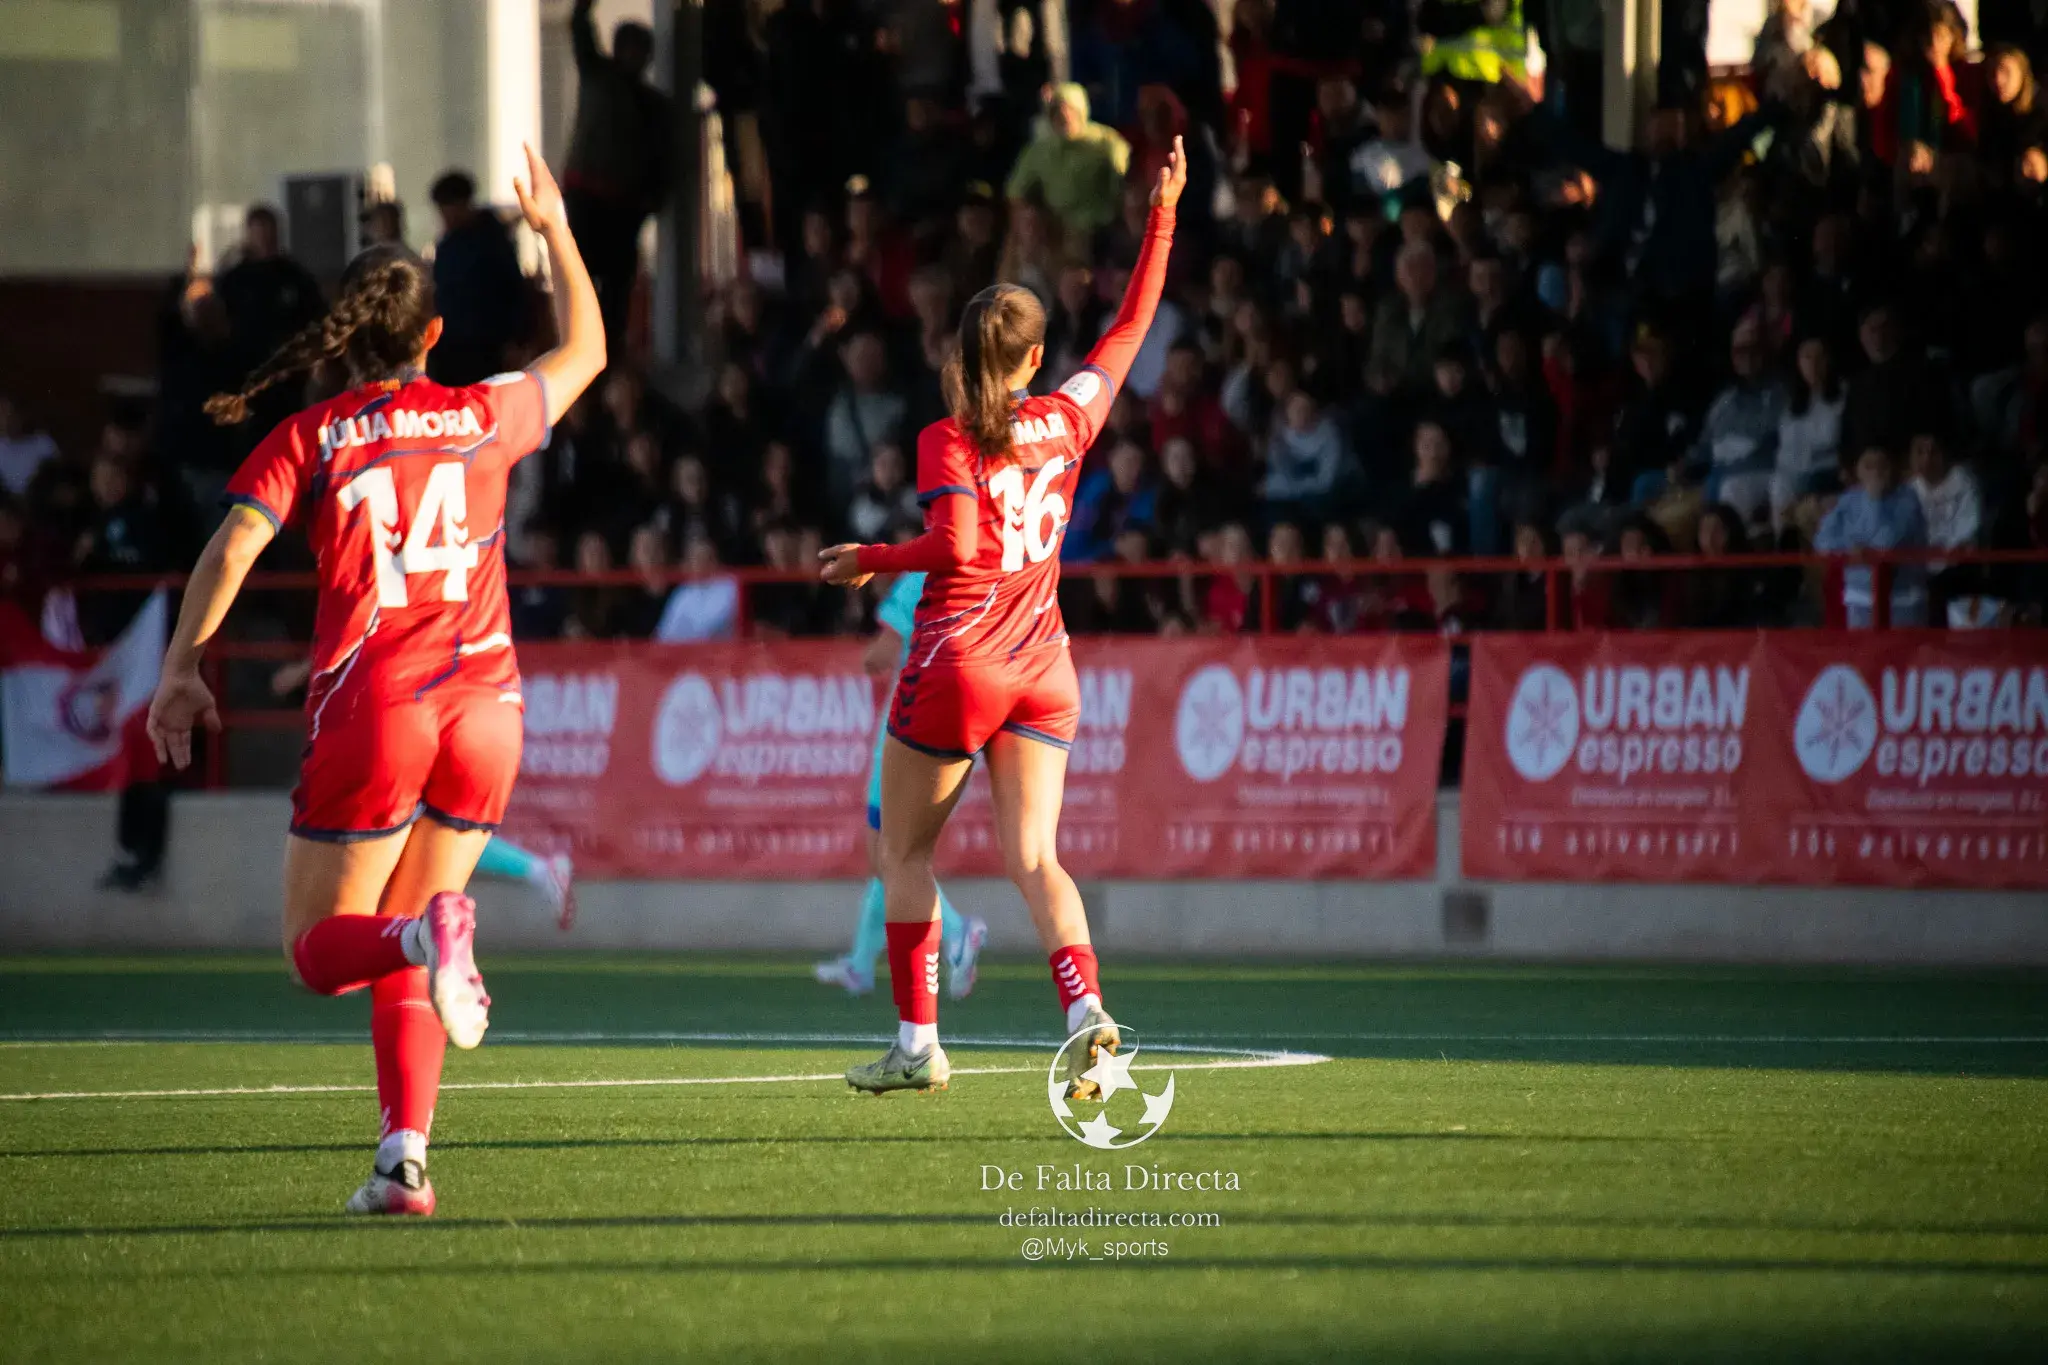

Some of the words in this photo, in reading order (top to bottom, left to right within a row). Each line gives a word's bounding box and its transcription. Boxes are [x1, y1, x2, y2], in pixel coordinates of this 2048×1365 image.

[393, 406, 484, 439] MORA
[337, 462, 479, 608] 14
[989, 456, 1067, 573] 16
[522, 672, 619, 736] BAN
[723, 673, 875, 735] URBAN
[1248, 664, 1411, 731] URBAN
[1583, 664, 1749, 731] URBAN
[1882, 665, 2048, 734] URBAN
[714, 743, 867, 788] espresso
[1242, 733, 1403, 784] espresso
[1577, 733, 1743, 784] espresso
[1876, 735, 2048, 788] espresso
